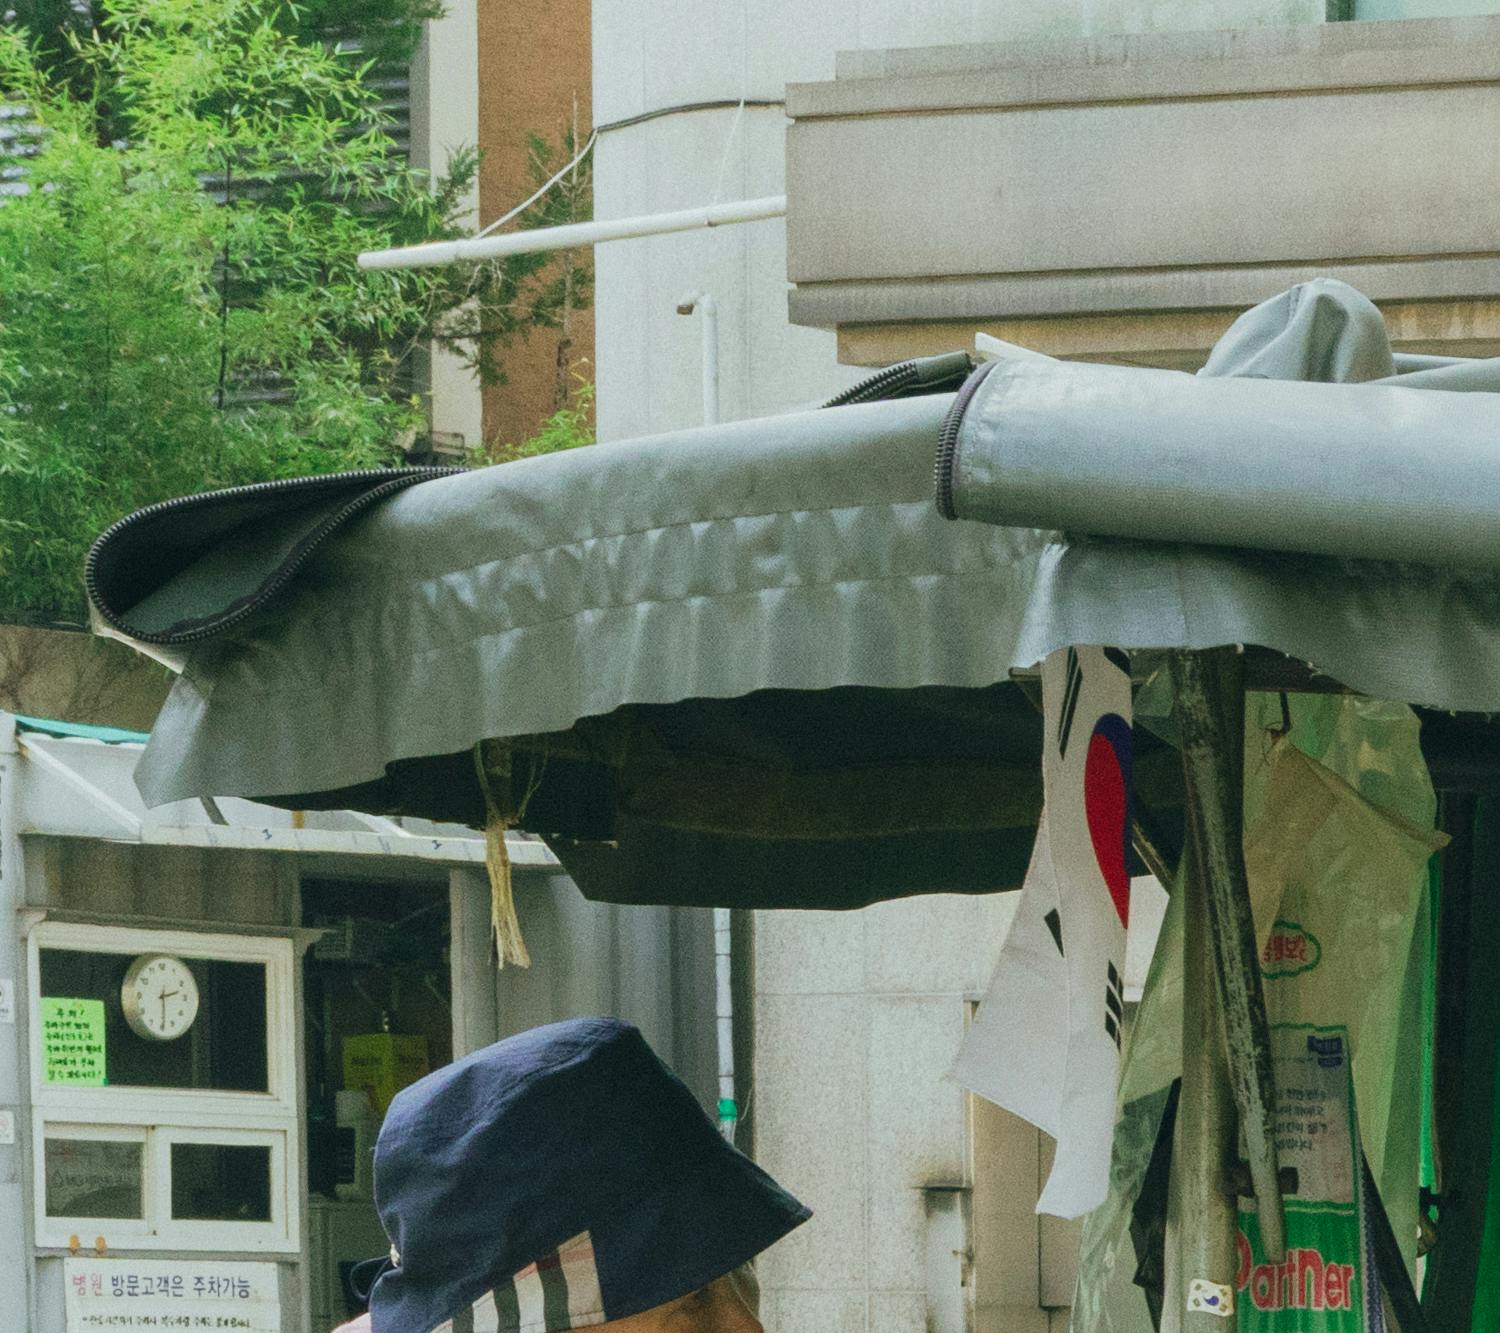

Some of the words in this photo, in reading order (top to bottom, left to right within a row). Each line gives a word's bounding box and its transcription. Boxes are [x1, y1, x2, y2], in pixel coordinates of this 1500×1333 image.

[72, 1273, 103, 1296] 병원
[112, 1275, 184, 1298] 방문고객은
[193, 1276, 250, 1299] 주차가능
